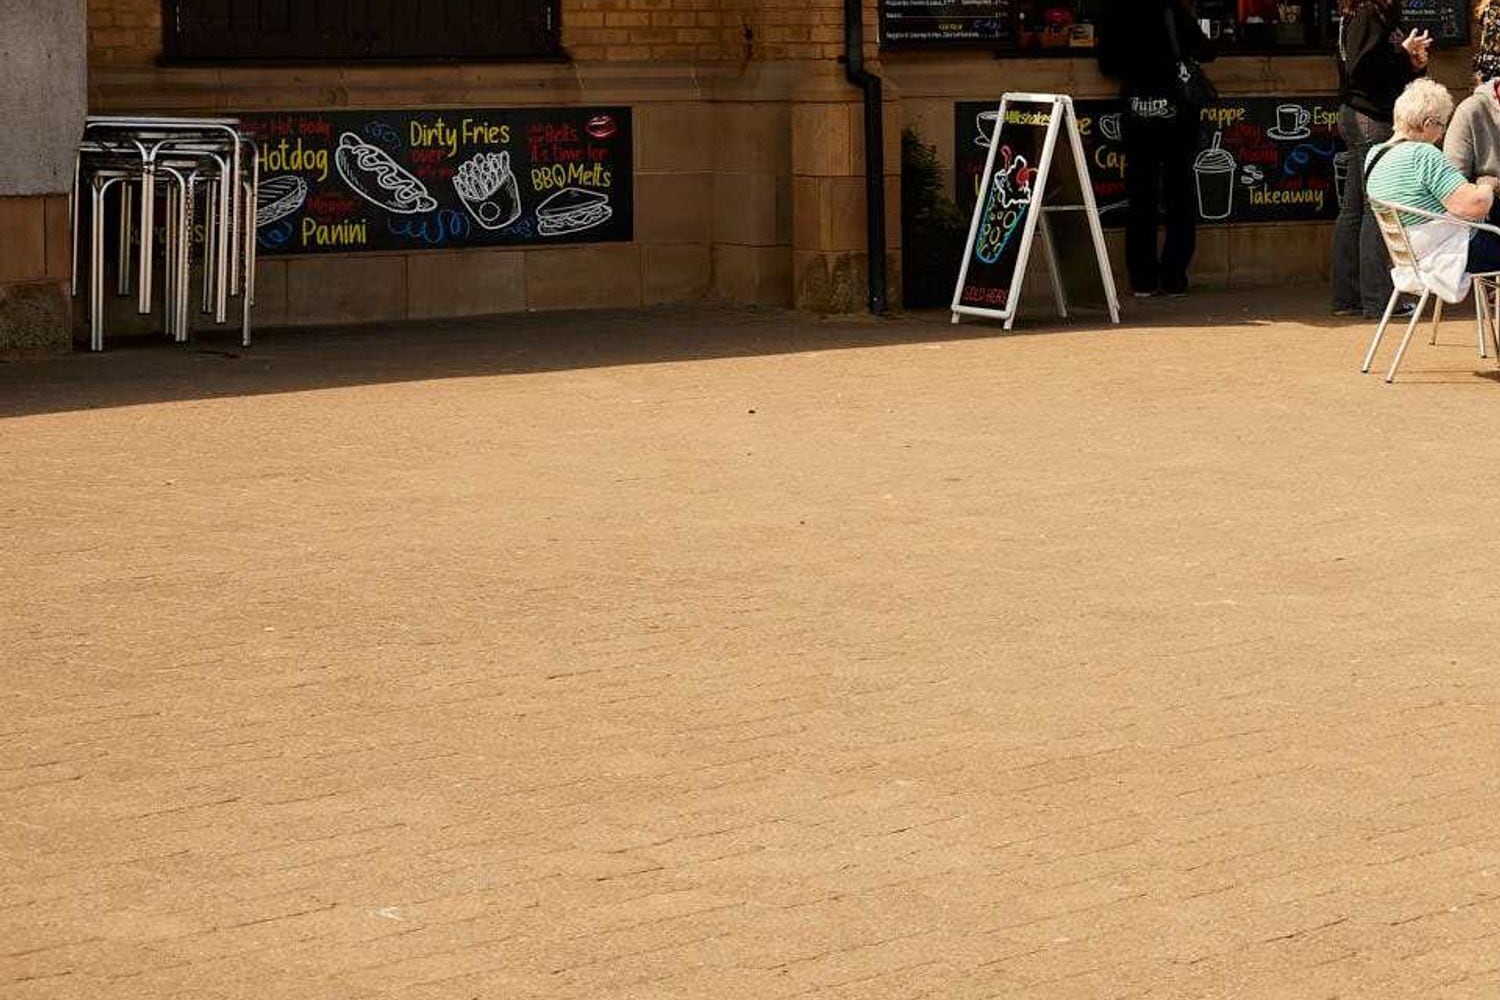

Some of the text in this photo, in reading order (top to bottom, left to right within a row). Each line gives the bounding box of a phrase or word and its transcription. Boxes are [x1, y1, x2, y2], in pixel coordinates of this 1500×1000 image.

[1199, 106, 1246, 130] rappe
[410, 118, 458, 158] Dirty
[462, 119, 511, 145] Fries
[256, 137, 328, 182] Hotdog
[531, 162, 612, 191] BBQ Melts
[1248, 181, 1324, 212] Takeaway
[302, 217, 367, 247] Panini
